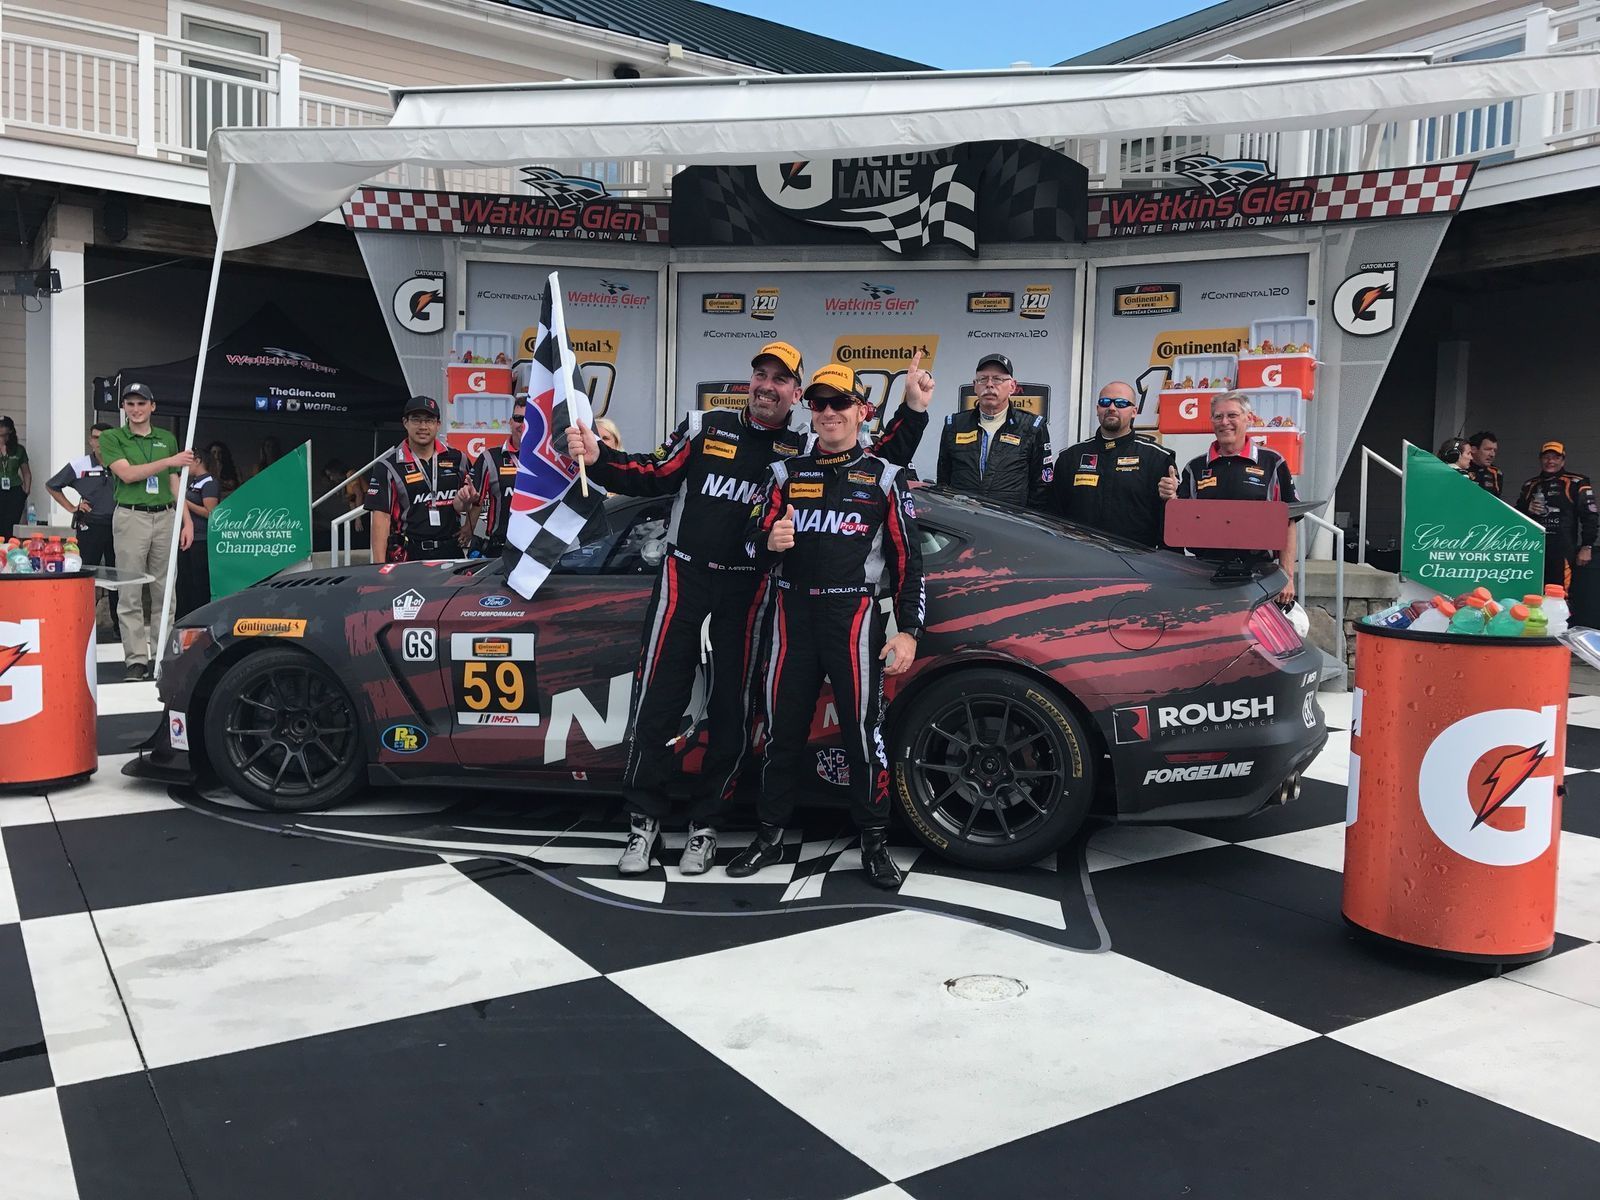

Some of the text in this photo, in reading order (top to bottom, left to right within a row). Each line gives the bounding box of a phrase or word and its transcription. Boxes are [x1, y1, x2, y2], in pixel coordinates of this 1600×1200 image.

[838, 169, 912, 199] LANE
[462, 198, 641, 231] Watkins Glen
[1111, 186, 1311, 225] Watkins Glen
[464, 225, 638, 240] INTERNATIONAL
[1113, 213, 1306, 235] INTERNATIONAL
[1360, 262, 1396, 270] GATORADE
[394, 277, 444, 333] G
[567, 291, 648, 306] Watkins Glen
[751, 295, 778, 310] 120
[825, 297, 916, 311] Watkins Glen
[1020, 293, 1050, 309] 120
[1124, 294, 1163, 305] Continental
[1333, 270, 1395, 335] G
[836, 344, 917, 363] Continental
[1156, 339, 1242, 359] Continental
[468, 371, 486, 391] G
[1262, 364, 1282, 387] G
[269, 387, 336, 398] TheGlen.com
[1178, 398, 1198, 420] G
[211, 507, 302, 532] Great Western
[840, 522, 869, 532] Pro MT
[221, 530, 292, 539] NEW YORK STATE
[1411, 523, 1543, 551] Great Western
[216, 541, 296, 557] Champagne
[1429, 551, 1529, 562] NEW YORK STATE
[1419, 563, 1534, 584] Champagne
[484, 596, 505, 607] Ford
[236, 620, 291, 633] Continental
[405, 631, 432, 658] GS
[463, 661, 525, 711] 59
[491, 714, 519, 724] IMSA
[1158, 695, 1275, 729] ROUSH
[1160, 718, 1276, 737] PERFORMANCE
[1142, 760, 1255, 786] FORGELINE
[1418, 704, 1558, 867] G
